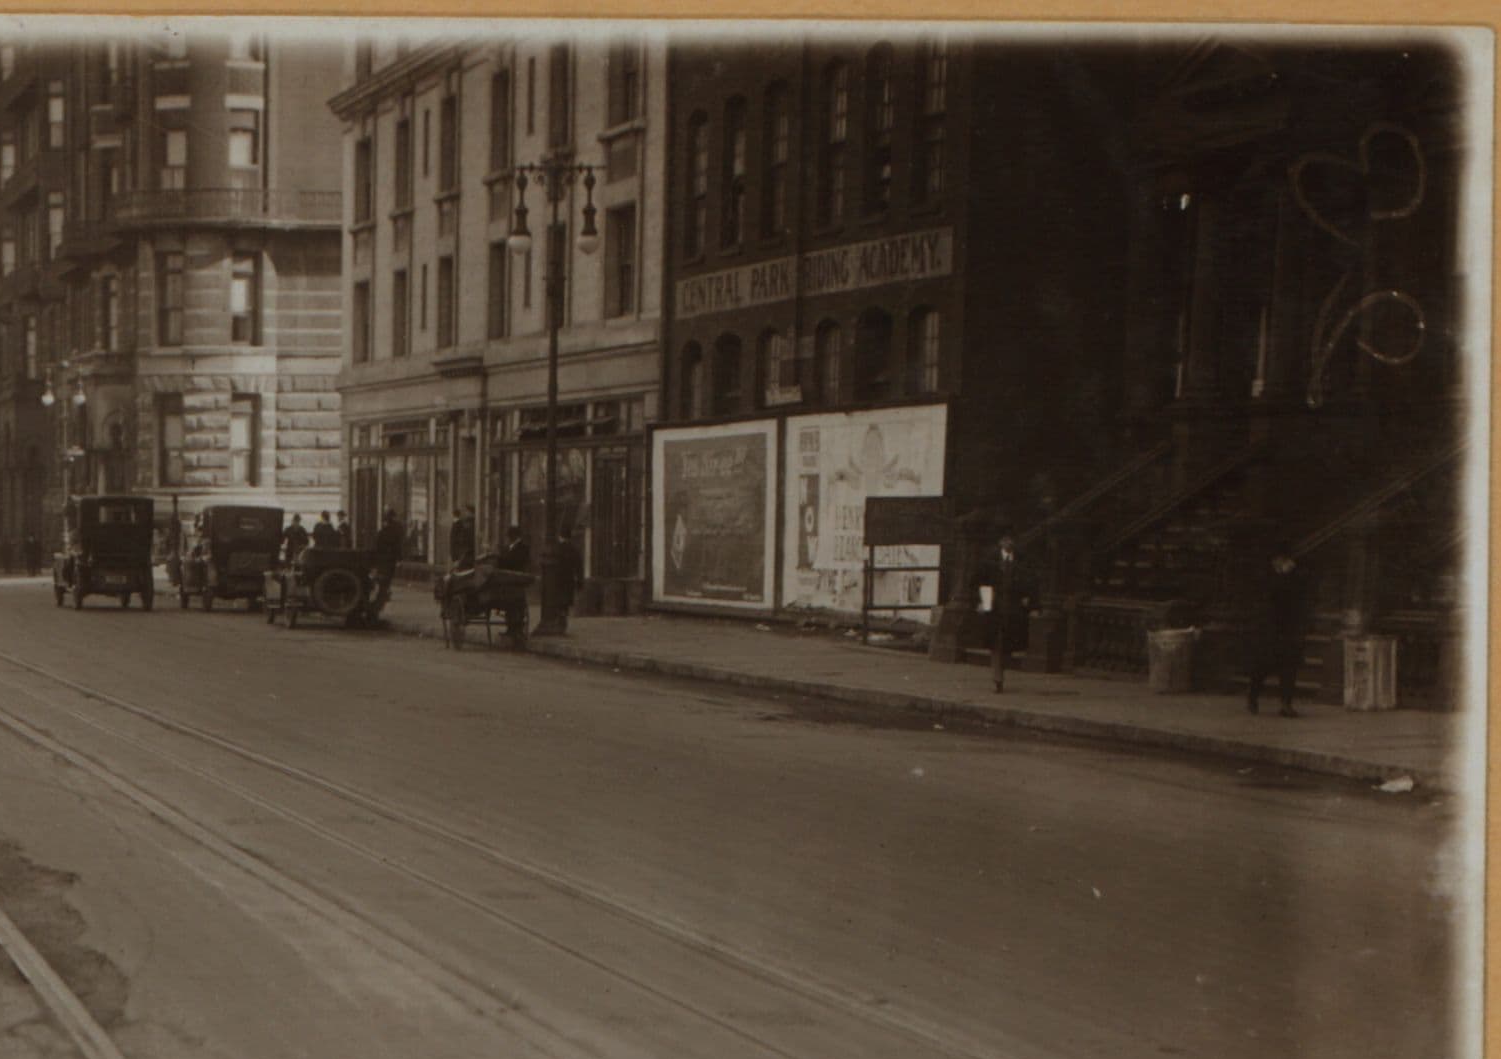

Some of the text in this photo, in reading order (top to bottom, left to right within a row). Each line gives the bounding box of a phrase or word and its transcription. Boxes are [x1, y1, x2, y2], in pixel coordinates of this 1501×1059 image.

[682, 271, 740, 310] CENTRAL
[751, 261, 789, 298] PARK
[803, 250, 849, 290] RIDING
